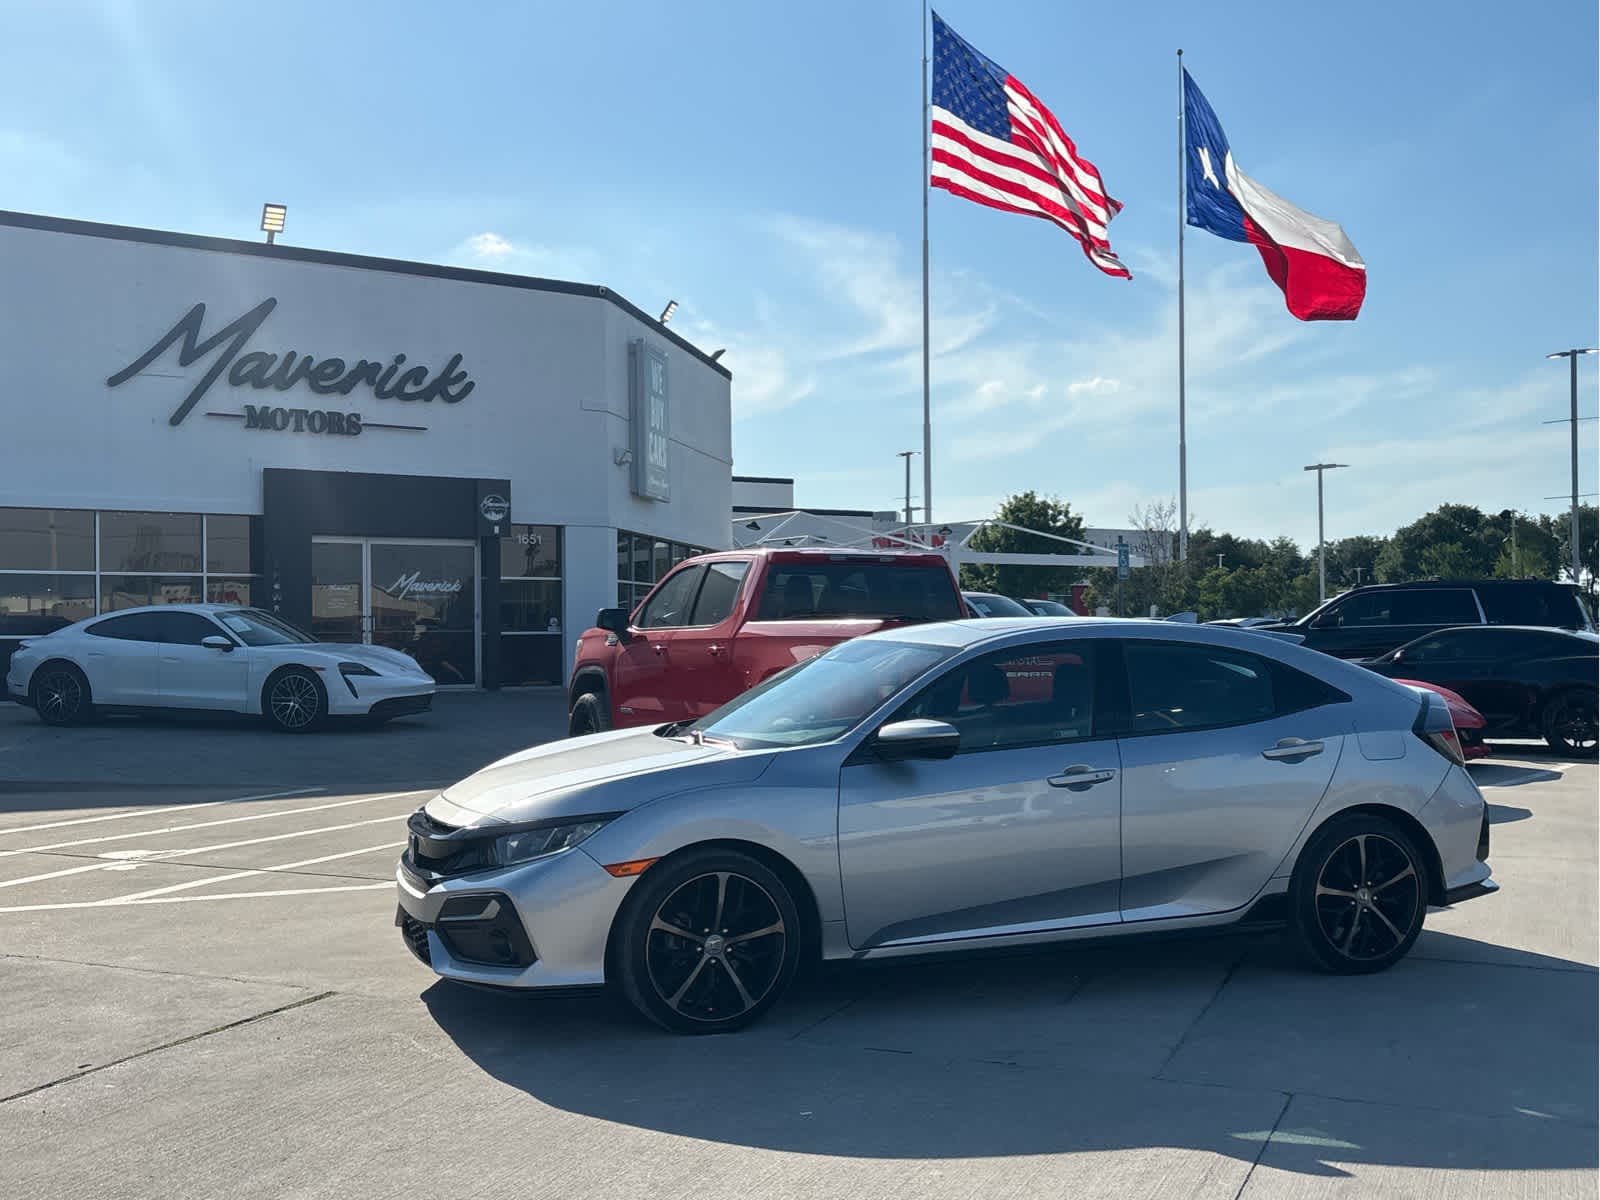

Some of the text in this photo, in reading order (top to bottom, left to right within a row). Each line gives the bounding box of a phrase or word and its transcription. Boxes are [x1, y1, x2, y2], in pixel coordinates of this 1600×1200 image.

[106, 297, 475, 427] Maverick
[243, 404, 363, 437] MOTORS
[649, 431, 666, 468] CARS
[516, 533, 542, 545] 1651
[386, 570, 462, 601] Maverick
[1006, 671, 1054, 680] ERRA
